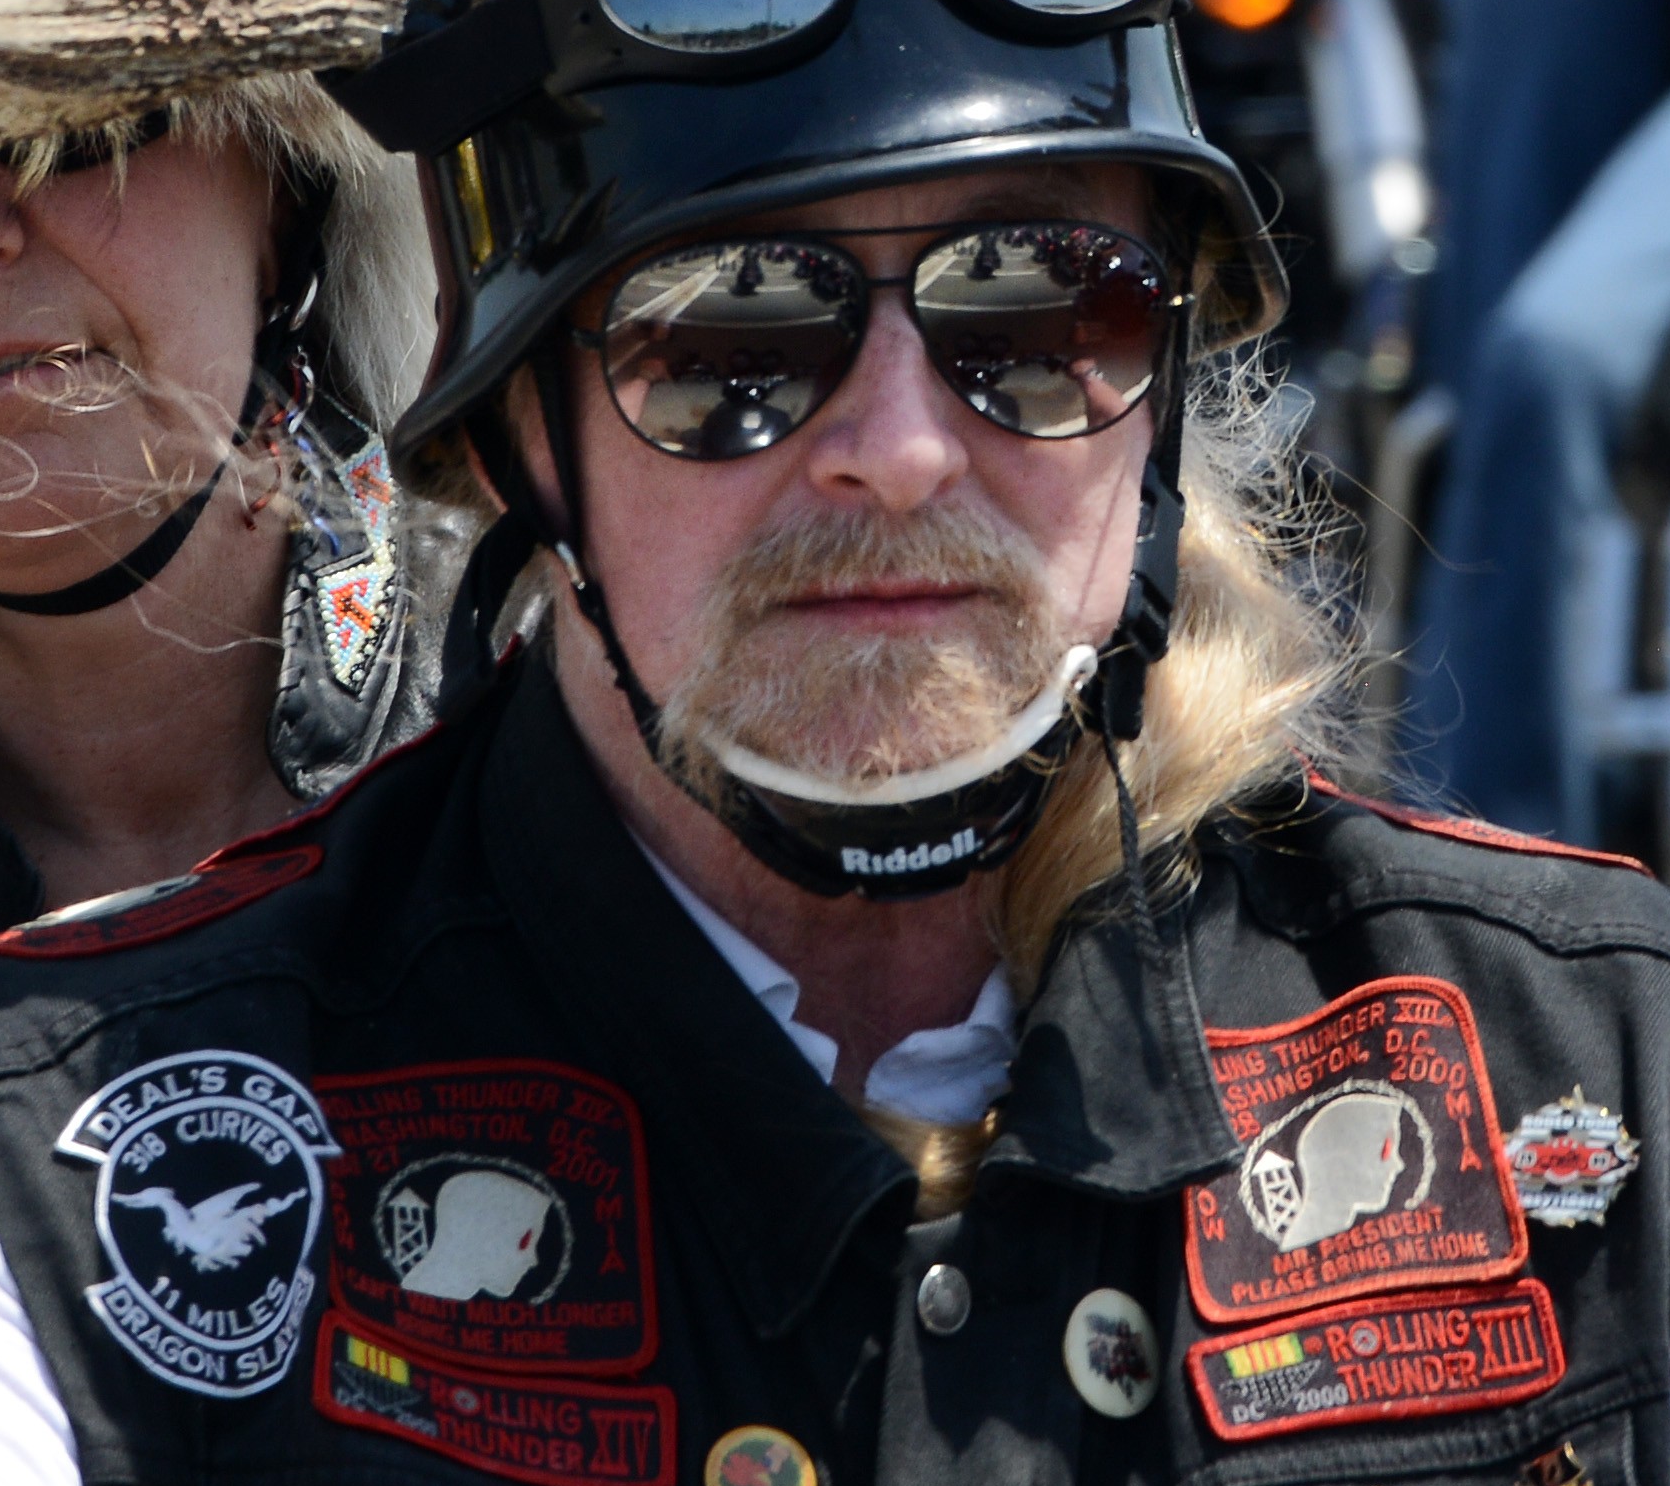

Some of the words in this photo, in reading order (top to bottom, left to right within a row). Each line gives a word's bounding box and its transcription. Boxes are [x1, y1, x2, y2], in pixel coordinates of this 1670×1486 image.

[1270, 1001, 1386, 1068] THUNDER
[87, 1065, 228, 1142] DEAL'S
[241, 1073, 322, 1138] GAP
[431, 1081, 562, 1110] THUNDER
[1222, 1041, 1371, 1114] SHINGTON,
[1385, 1027, 1437, 1059] D.C.
[1390, 1055, 1468, 1090] 2000
[121, 1131, 168, 1174] 318
[175, 1109, 294, 1166] CURVES
[1445, 1091, 1483, 1174] MIA
[594, 1194, 628, 1276] MIA
[1196, 1187, 1226, 1243] OW
[1271, 1246, 1316, 1274] MR.
[1318, 1205, 1444, 1260] PRESIDENT
[1231, 1266, 1319, 1306] PLEASE
[1320, 1246, 1392, 1282] BRING
[1394, 1238, 1429, 1266] ME
[1430, 1230, 1492, 1260] HOME
[106, 1289, 227, 1381] DRAGON
[150, 1275, 181, 1310] 11
[186, 1276, 289, 1338] MILES
[1323, 1308, 1471, 1363] ROLLING
[1470, 1304, 1545, 1381] XIII
[430, 1381, 582, 1435] ROLLING
[1231, 1402, 1267, 1425] DC
[1292, 1382, 1350, 1414] 2000
[1335, 1349, 1479, 1403] THUNDER
[433, 1412, 586, 1471] THUNDER
[587, 1409, 656, 1478] XIV
